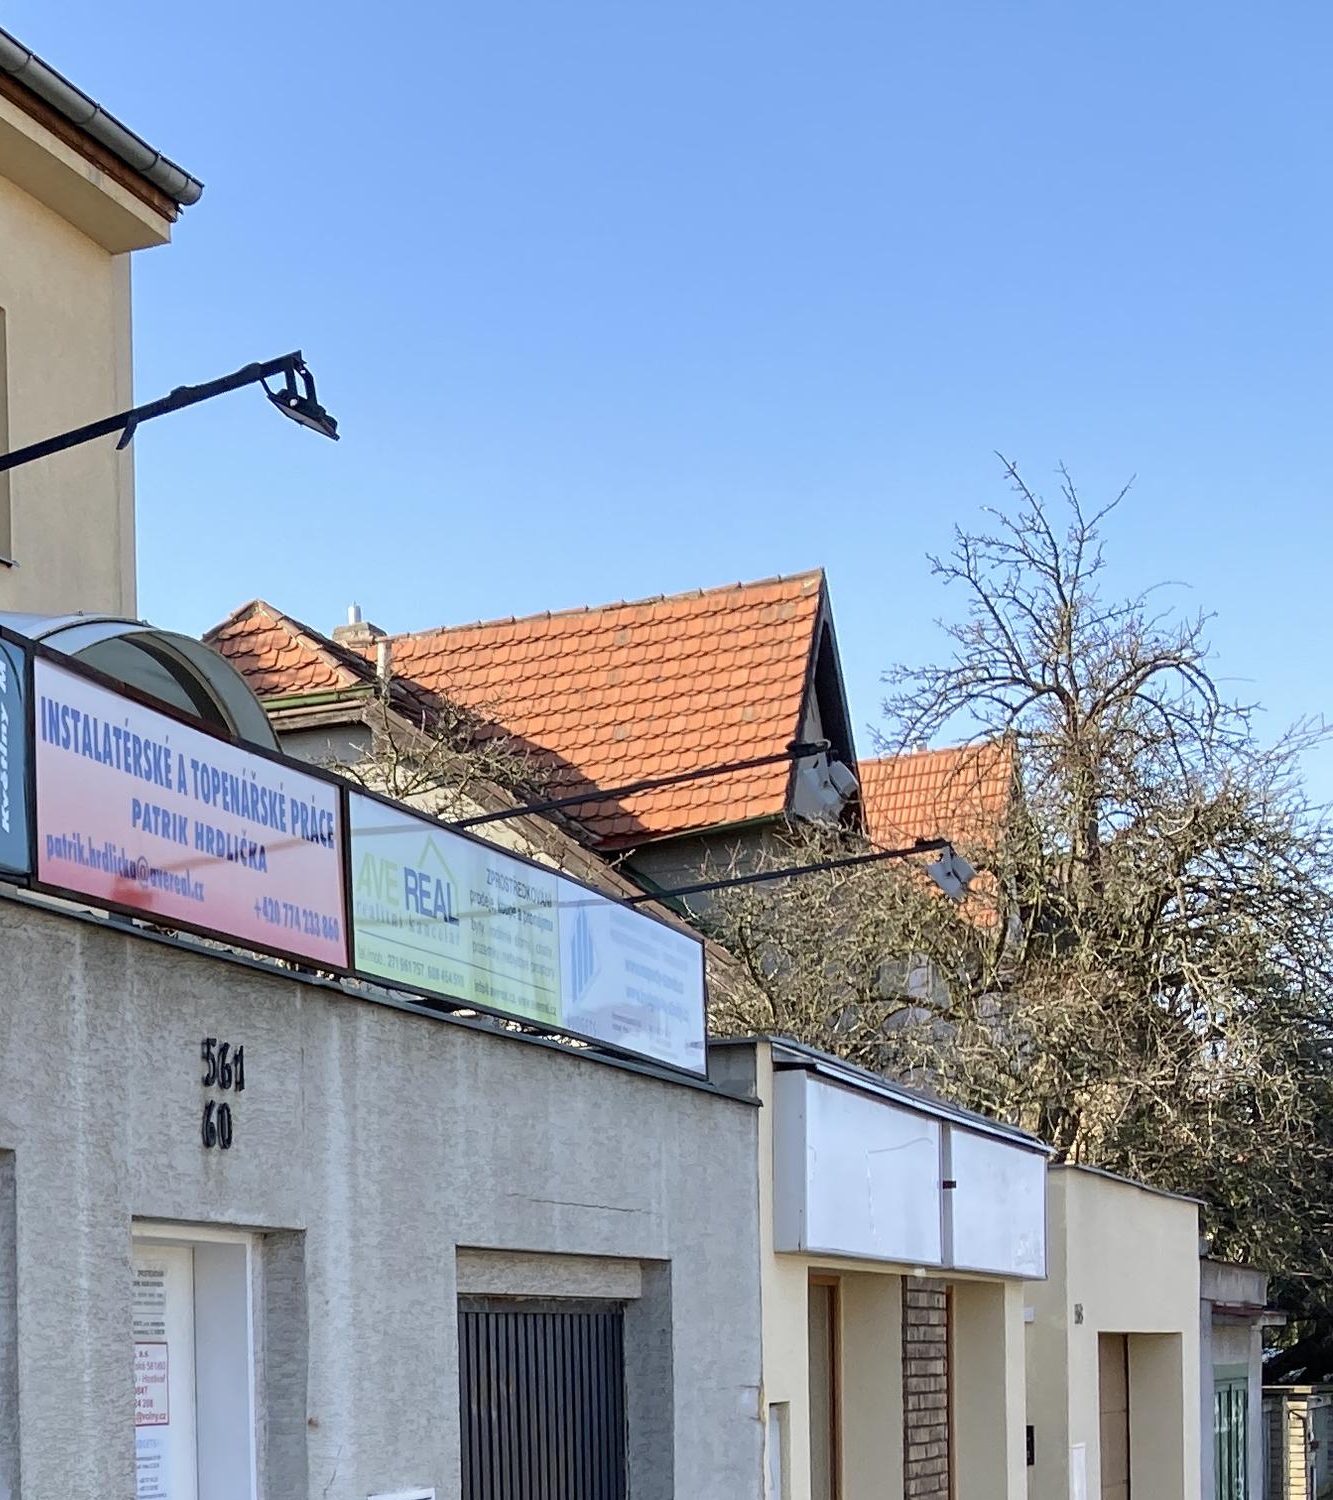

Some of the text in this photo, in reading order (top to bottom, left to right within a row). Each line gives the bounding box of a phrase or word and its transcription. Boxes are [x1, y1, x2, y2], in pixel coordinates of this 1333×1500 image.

[40, 696, 335, 850] INSTALATÉRSKÉ A TOPENÁŘSKÉ PRÁCE
[132, 798, 268, 873] PATRIK HRDLIČKA
[356, 852, 460, 926] AVE REAL
[201, 1038, 245, 1092] 561
[202, 1100, 232, 1150] 60
